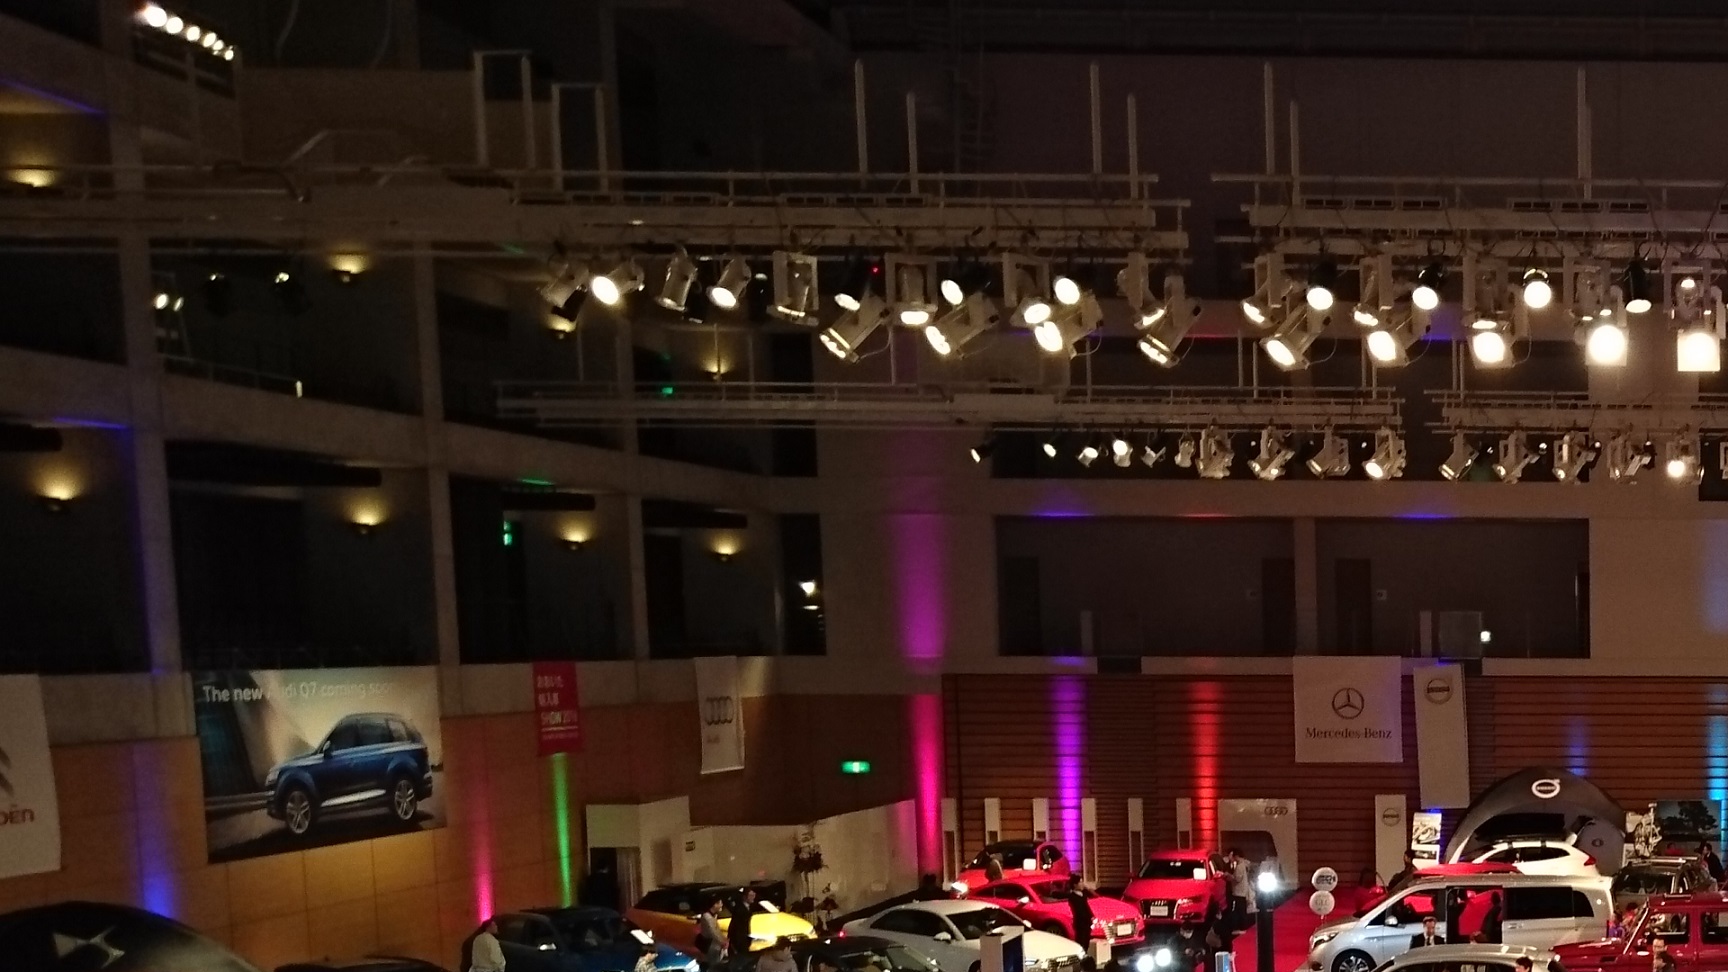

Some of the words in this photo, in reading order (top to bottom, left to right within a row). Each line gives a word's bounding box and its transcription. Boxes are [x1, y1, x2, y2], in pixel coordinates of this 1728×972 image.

[203, 685, 230, 702] The
[233, 687, 264, 701] new
[299, 681, 317, 699] Q7
